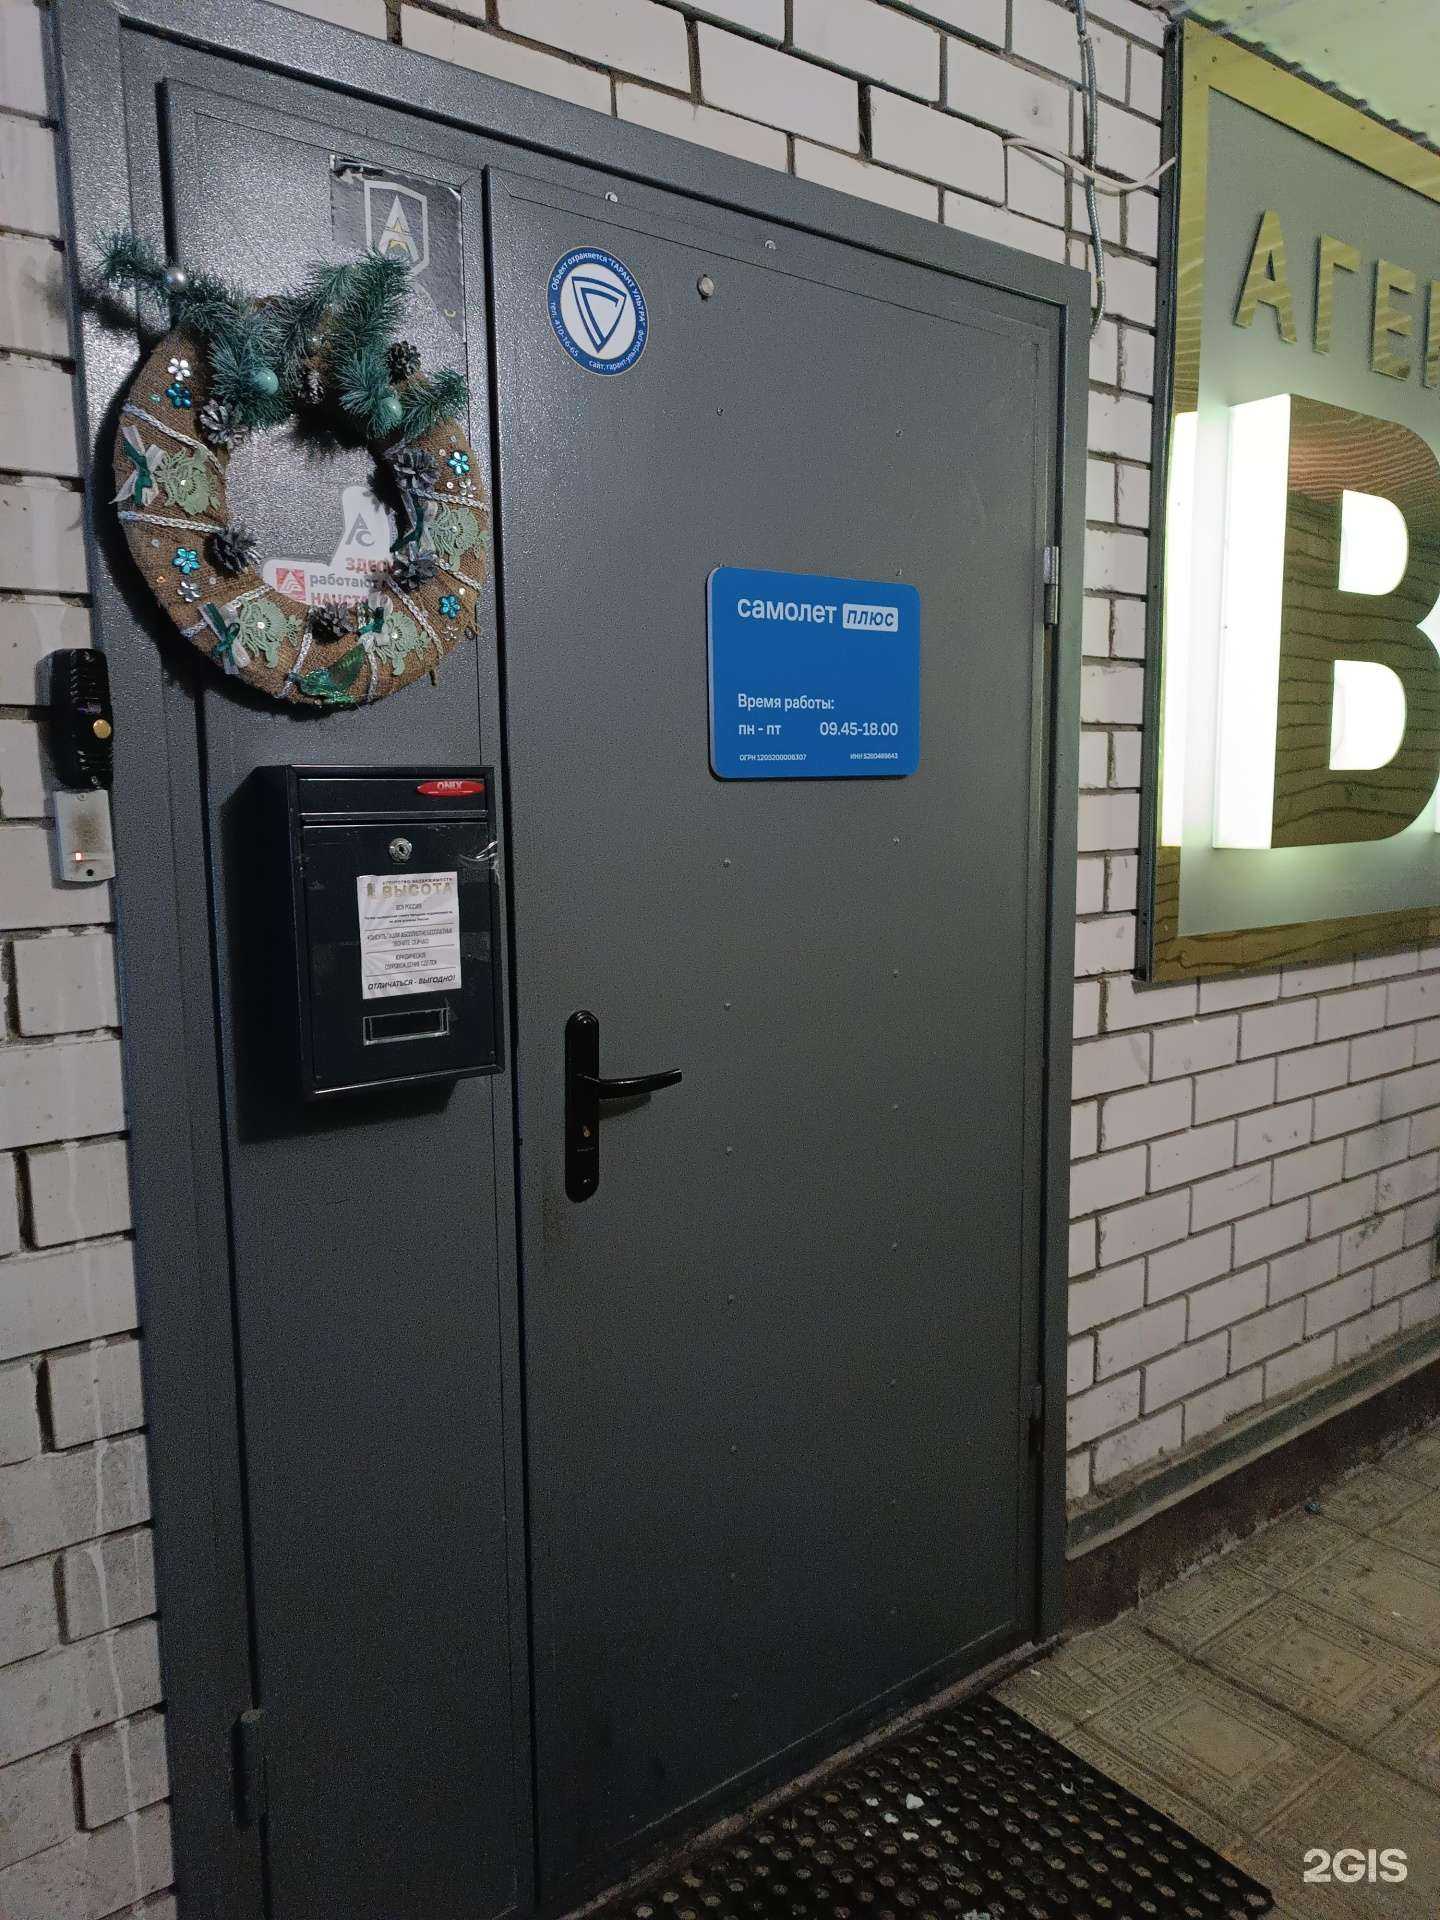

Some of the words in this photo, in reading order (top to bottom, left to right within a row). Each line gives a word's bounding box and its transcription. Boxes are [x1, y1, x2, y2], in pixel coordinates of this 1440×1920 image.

[736, 598, 838, 624] самолет
[737, 693, 781, 711] Время
[784, 695, 835, 711] работы:
[819, 722, 899, 736] 09.45-18.00
[367, 979, 413, 991] ОТЛИЧАТЬСЯ
[418, 974, 456, 985] ВЫГОДНО!
